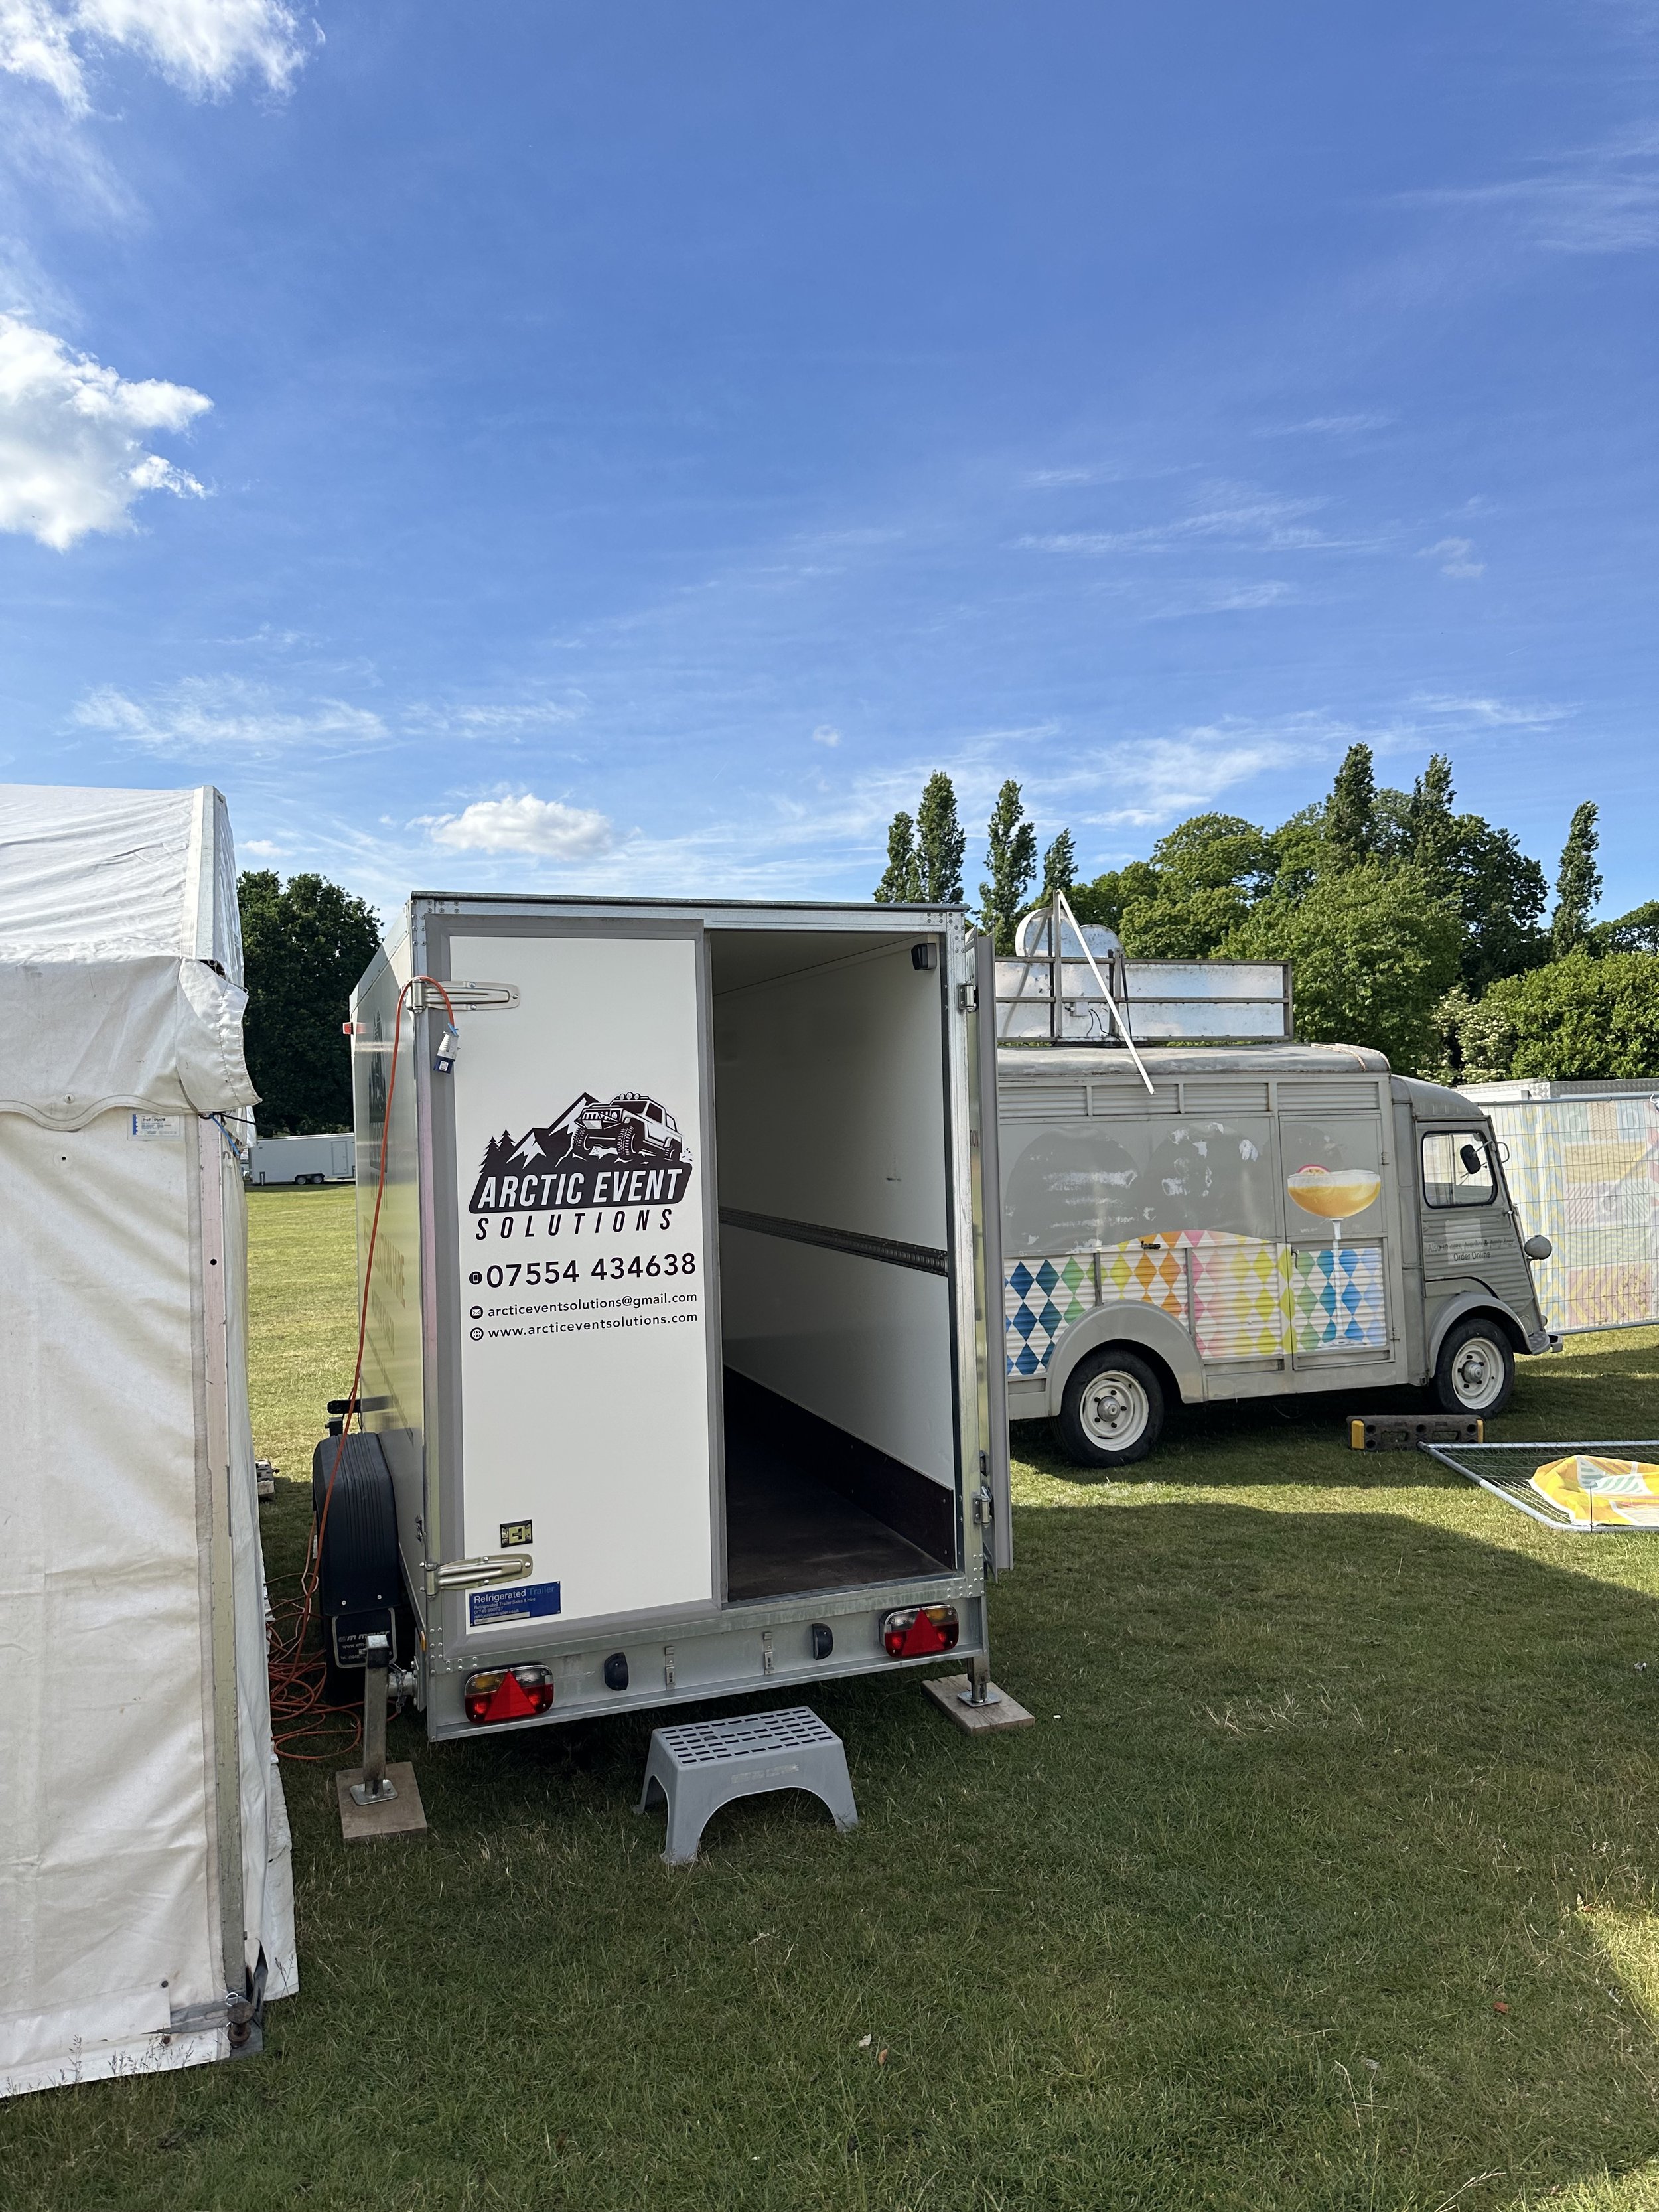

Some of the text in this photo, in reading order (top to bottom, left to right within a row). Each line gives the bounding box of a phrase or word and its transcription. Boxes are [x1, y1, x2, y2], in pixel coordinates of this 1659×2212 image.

[478, 1169, 682, 1209] ARCTIC EVENT
[475, 1209, 672, 1240] SOLUTIONS
[486, 1252, 696, 1288] 07554 434638
[1453, 1251, 1491, 1262] Order Online
[488, 1292, 697, 1317] arcticeventsolutions@gmail.com
[488, 1312, 697, 1339] www.arcticeventsolutions.com
[474, 1586, 555, 1603] Refrigerated Trailer
